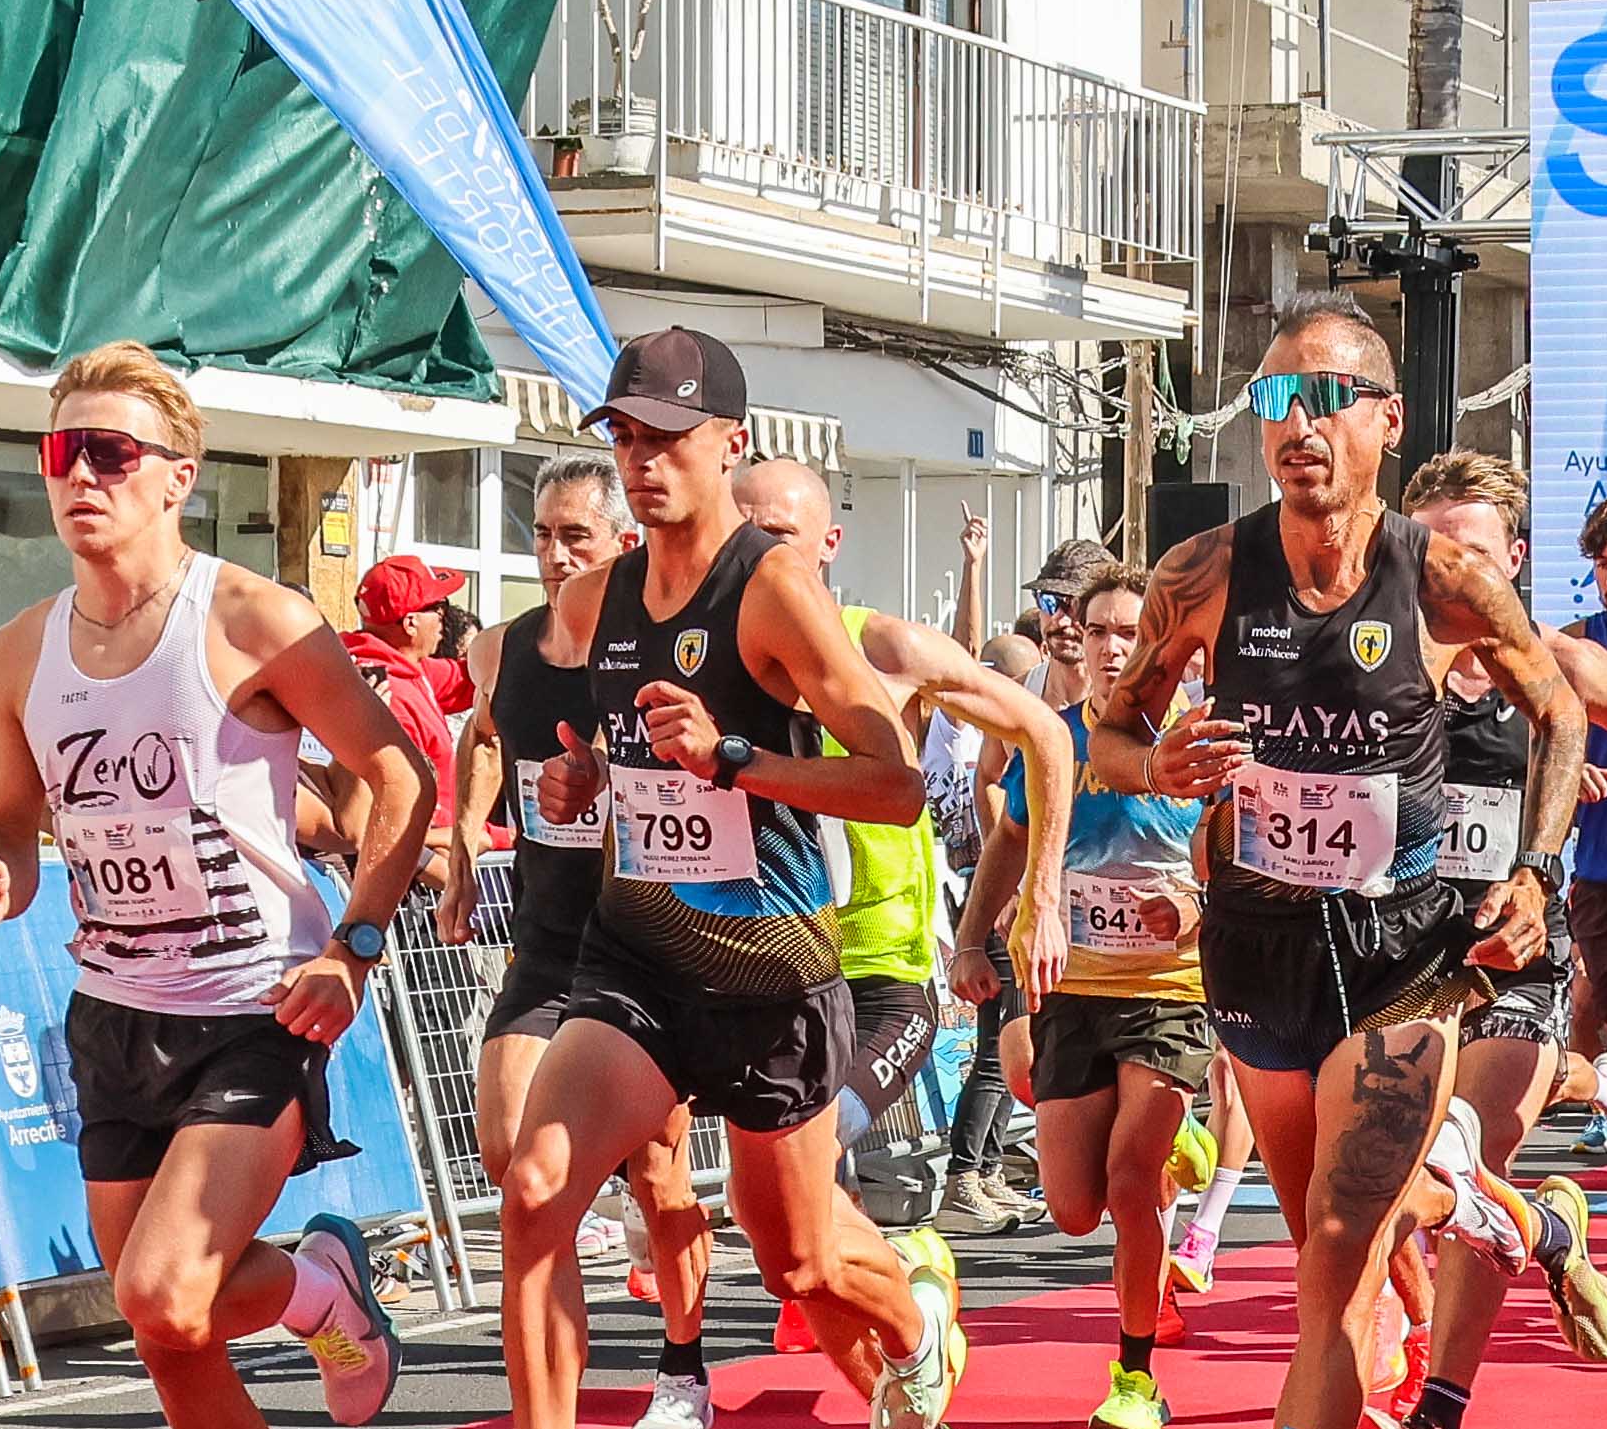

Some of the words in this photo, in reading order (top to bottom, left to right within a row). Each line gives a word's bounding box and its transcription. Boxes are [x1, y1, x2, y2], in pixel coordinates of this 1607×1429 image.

[607, 639, 637, 653] mobel
[1251, 625, 1291, 640] mobel
[1242, 703, 1390, 742] PLAYAS
[635, 812, 713, 852] 799
[1267, 812, 1357, 858] 314
[1443, 820, 1488, 854] 10
[82, 854, 176, 895] 1081
[55, 1100, 68, 1112] de
[8, 1118, 66, 1147] Arrecife
